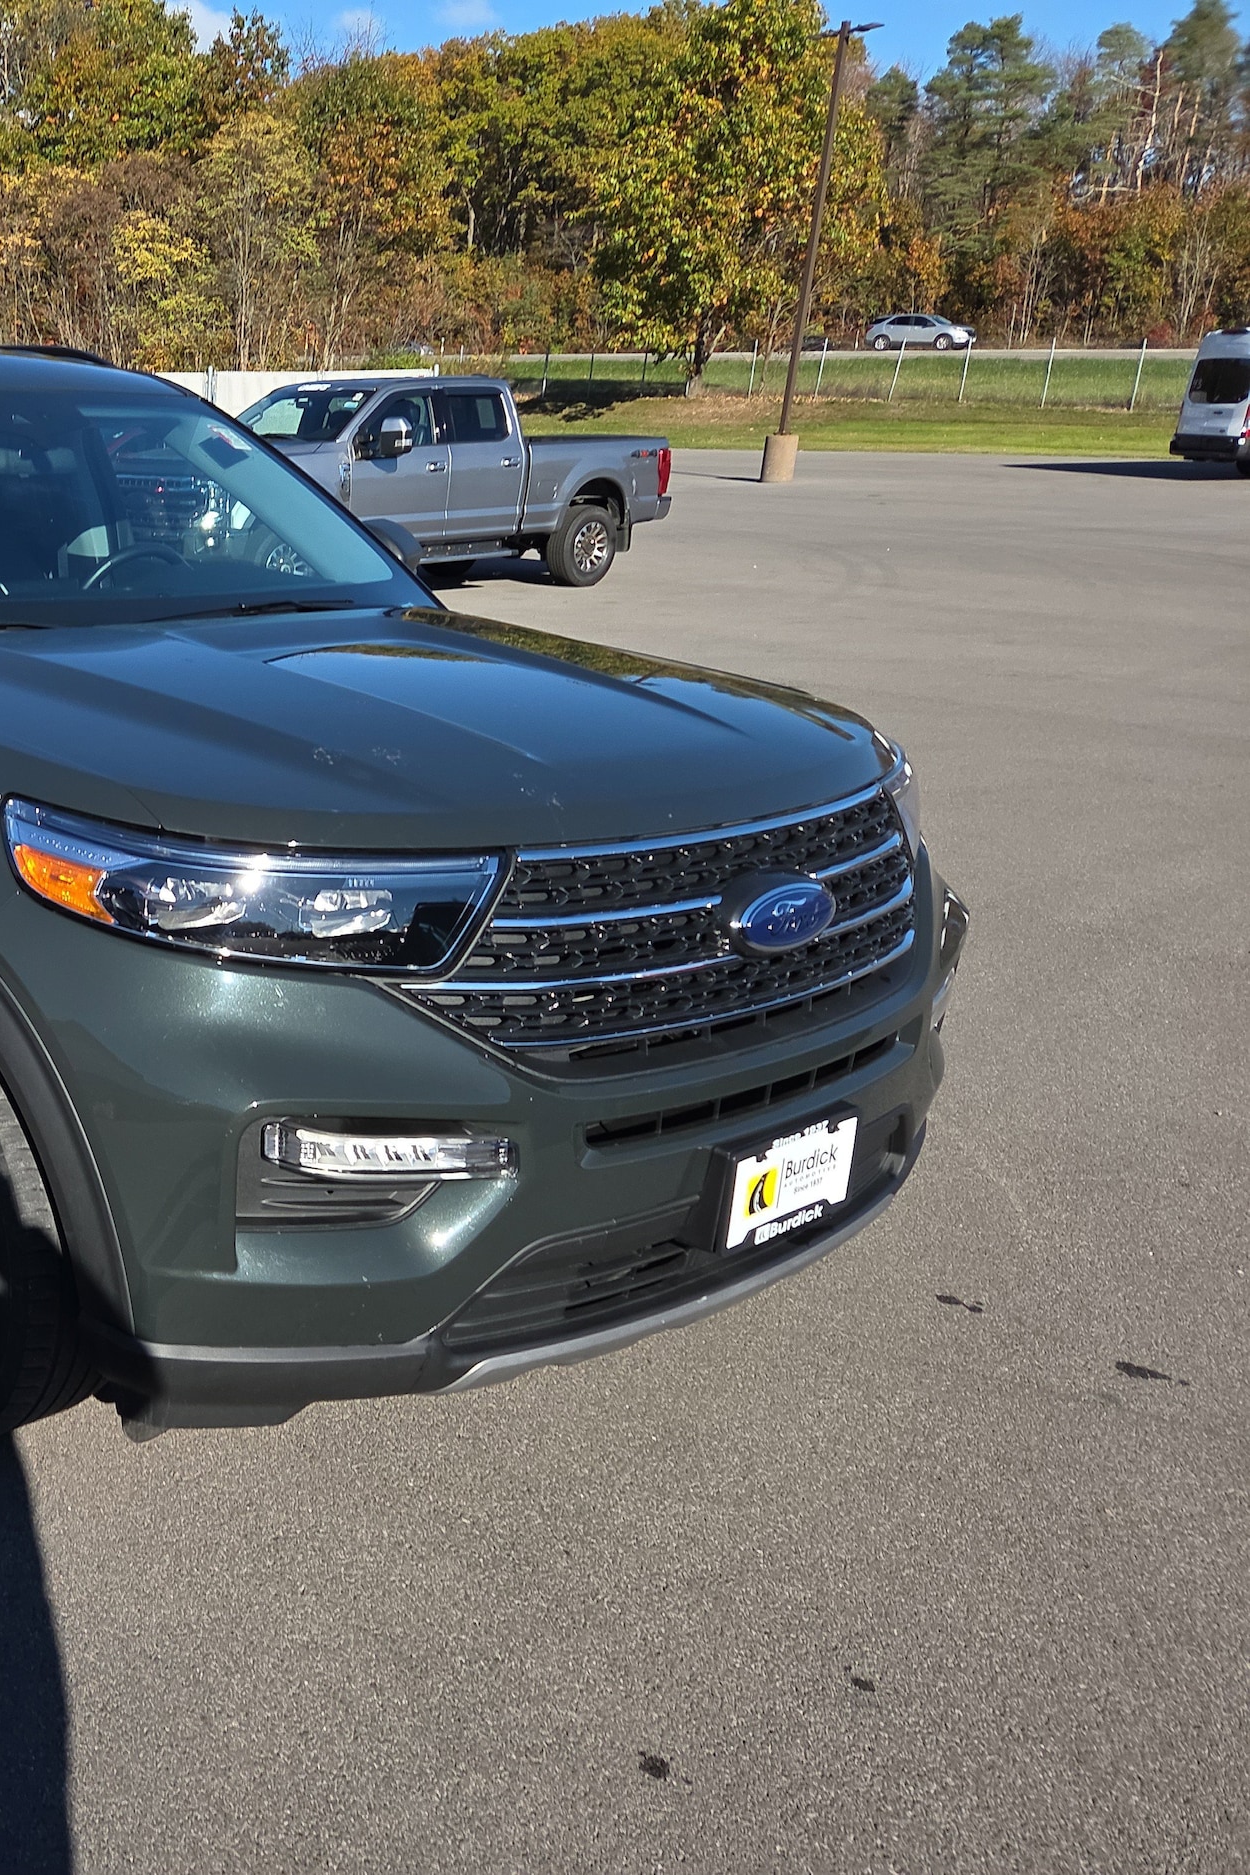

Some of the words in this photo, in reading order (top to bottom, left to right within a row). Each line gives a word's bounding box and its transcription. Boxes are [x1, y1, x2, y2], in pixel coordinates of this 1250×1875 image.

[786, 1144, 838, 1179] Burdick
[784, 1165, 836, 1188] AUTOMOTIVE
[793, 1184, 809, 1195] Since
[769, 1205, 823, 1237] Burdick
